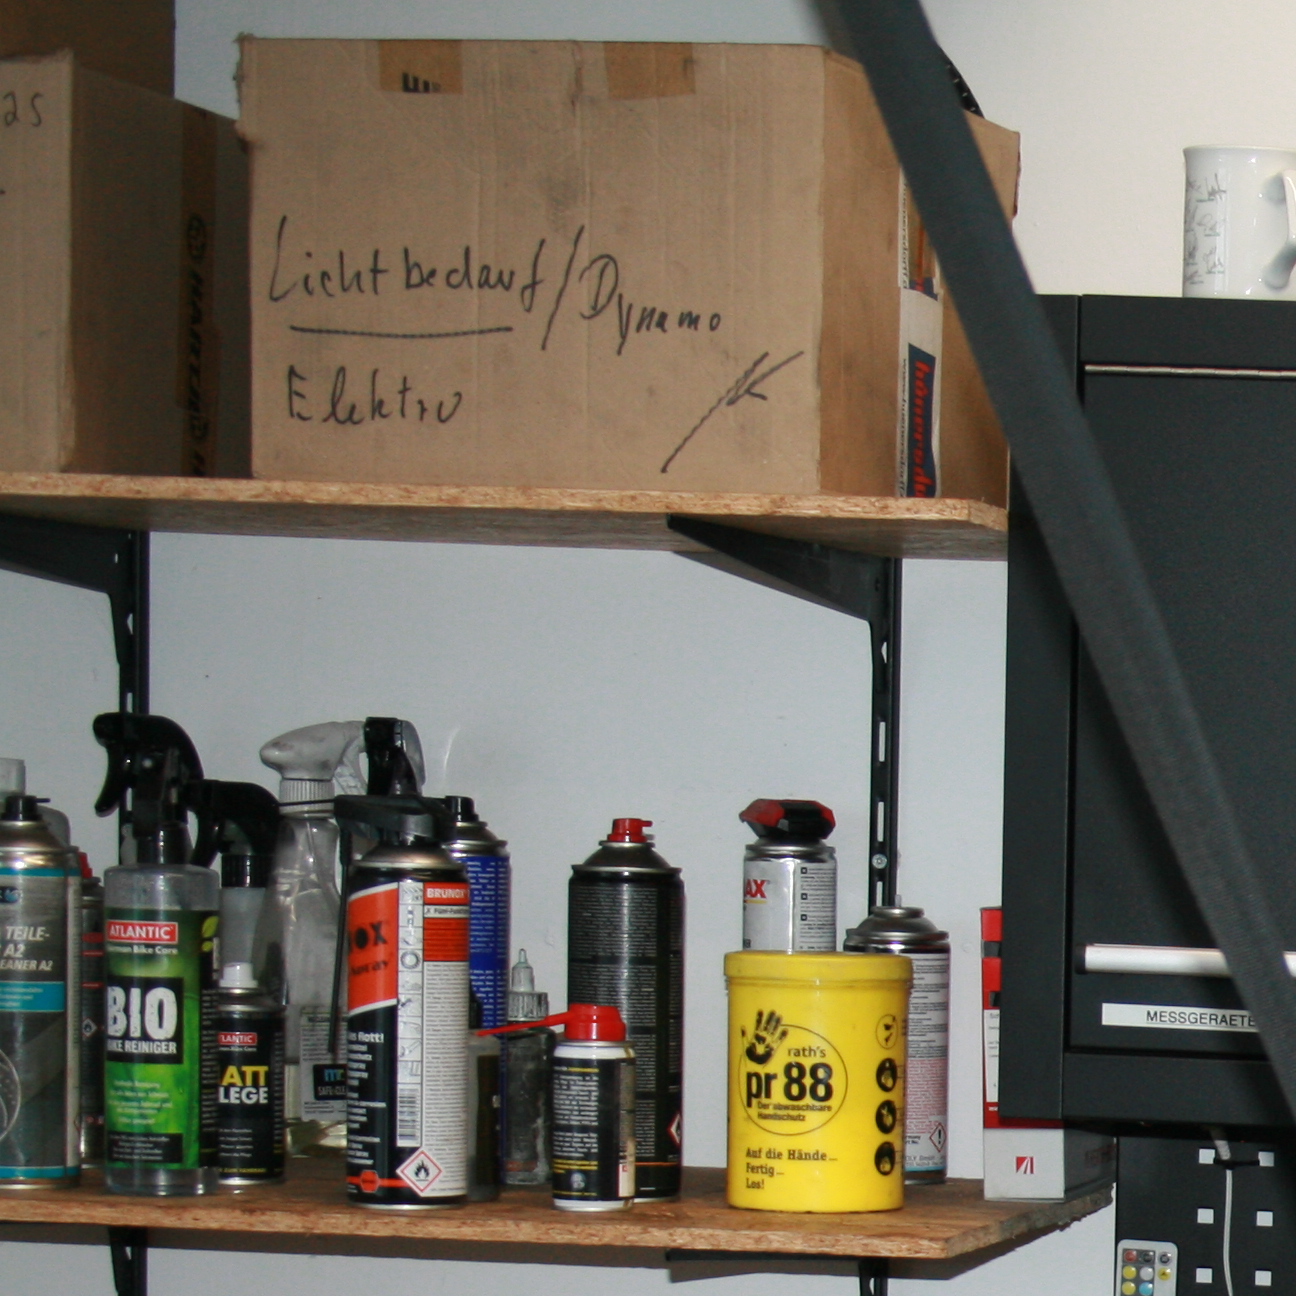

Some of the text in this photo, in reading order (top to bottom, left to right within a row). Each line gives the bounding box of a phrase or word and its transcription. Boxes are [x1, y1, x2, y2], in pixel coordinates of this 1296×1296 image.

[288, 364, 463, 424] Elektro
[744, 879, 767, 898] AX
[6, 926, 50, 941] TEILE-
[109, 925, 171, 939] ATLANTIC
[107, 986, 178, 1040] BIO
[1146, 1009, 1256, 1027] MESSGERAETE
[124, 1040, 177, 1053] REINIGER
[787, 1046, 827, 1058] rath's
[746, 1061, 834, 1108] pr 88
[746, 1147, 762, 1158] Auf
[765, 1148, 783, 1160] die
[746, 1178, 766, 1189] Los!
